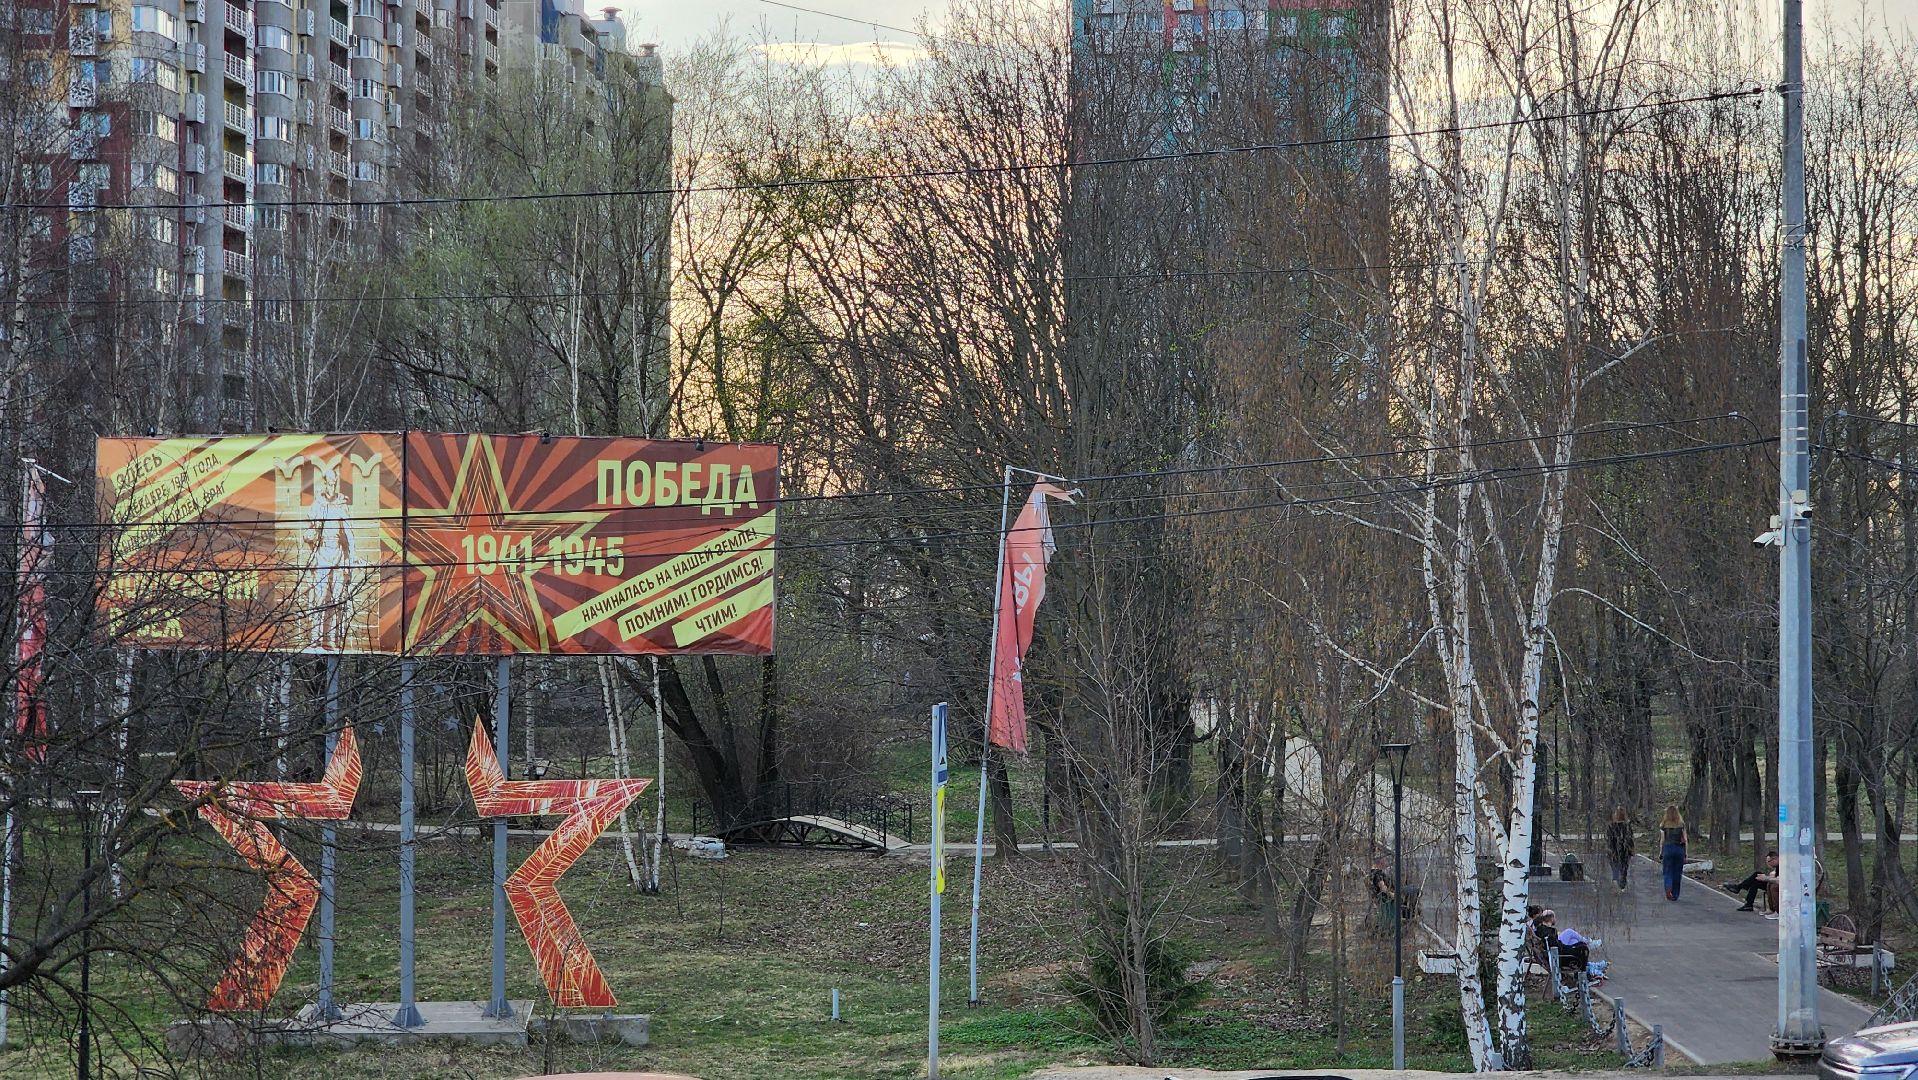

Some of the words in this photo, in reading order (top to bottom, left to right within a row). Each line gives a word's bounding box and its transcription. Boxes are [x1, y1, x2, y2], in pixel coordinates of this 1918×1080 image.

[193, 453, 222, 476] ГОДА,
[597, 459, 759, 516] ПОБЕДА
[462, 534, 625, 576] 1941-1945
[582, 577, 655, 623] НАЧИНАЛАСЬ
[656, 571, 672, 586] НА
[673, 545, 714, 577] НАШЕЙ
[714, 527, 759, 556] ЗЕМЛЕ!
[625, 592, 690, 634] ПОМНИМ!
[690, 555, 764, 602] ГОРДИМСЯ!
[695, 602, 738, 633] ЧТИМ!
